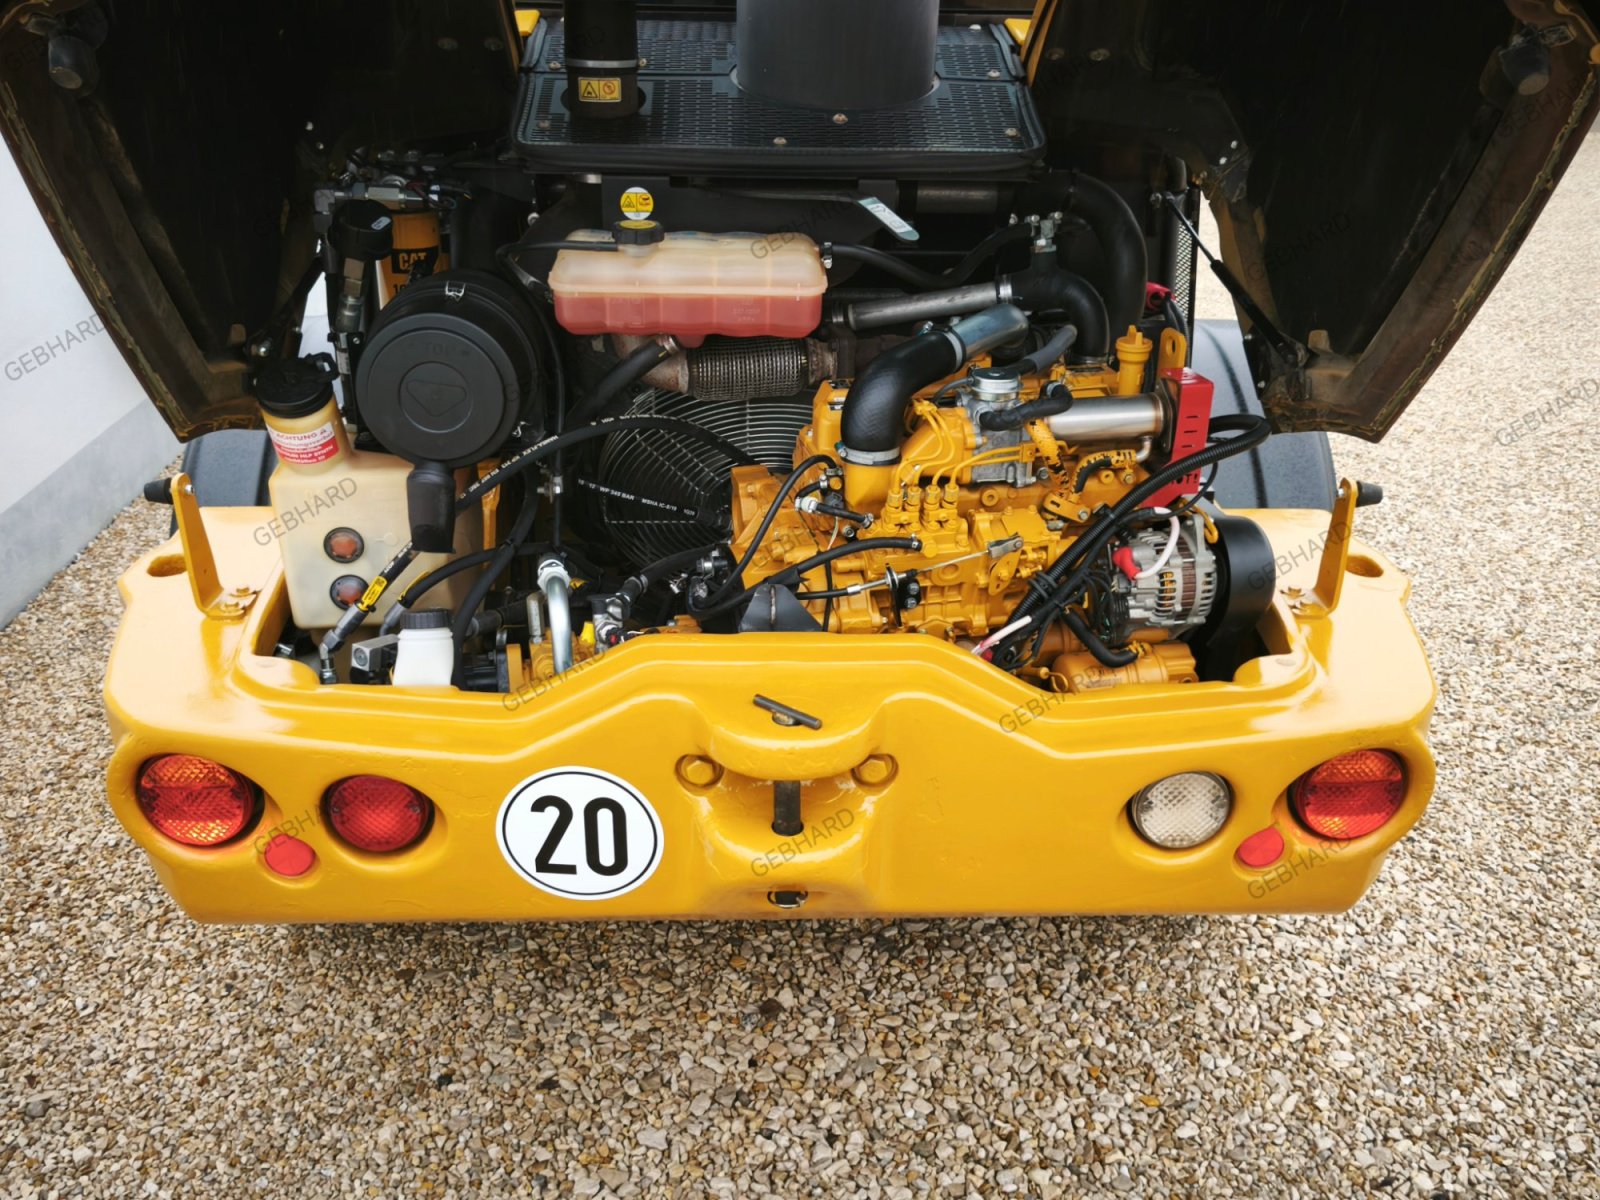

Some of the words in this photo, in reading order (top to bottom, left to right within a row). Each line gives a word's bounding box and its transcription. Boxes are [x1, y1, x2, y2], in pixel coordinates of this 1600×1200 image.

[398, 252, 427, 271] CAT
[621, 492, 635, 501] BAR
[531, 795, 628, 876] 20
